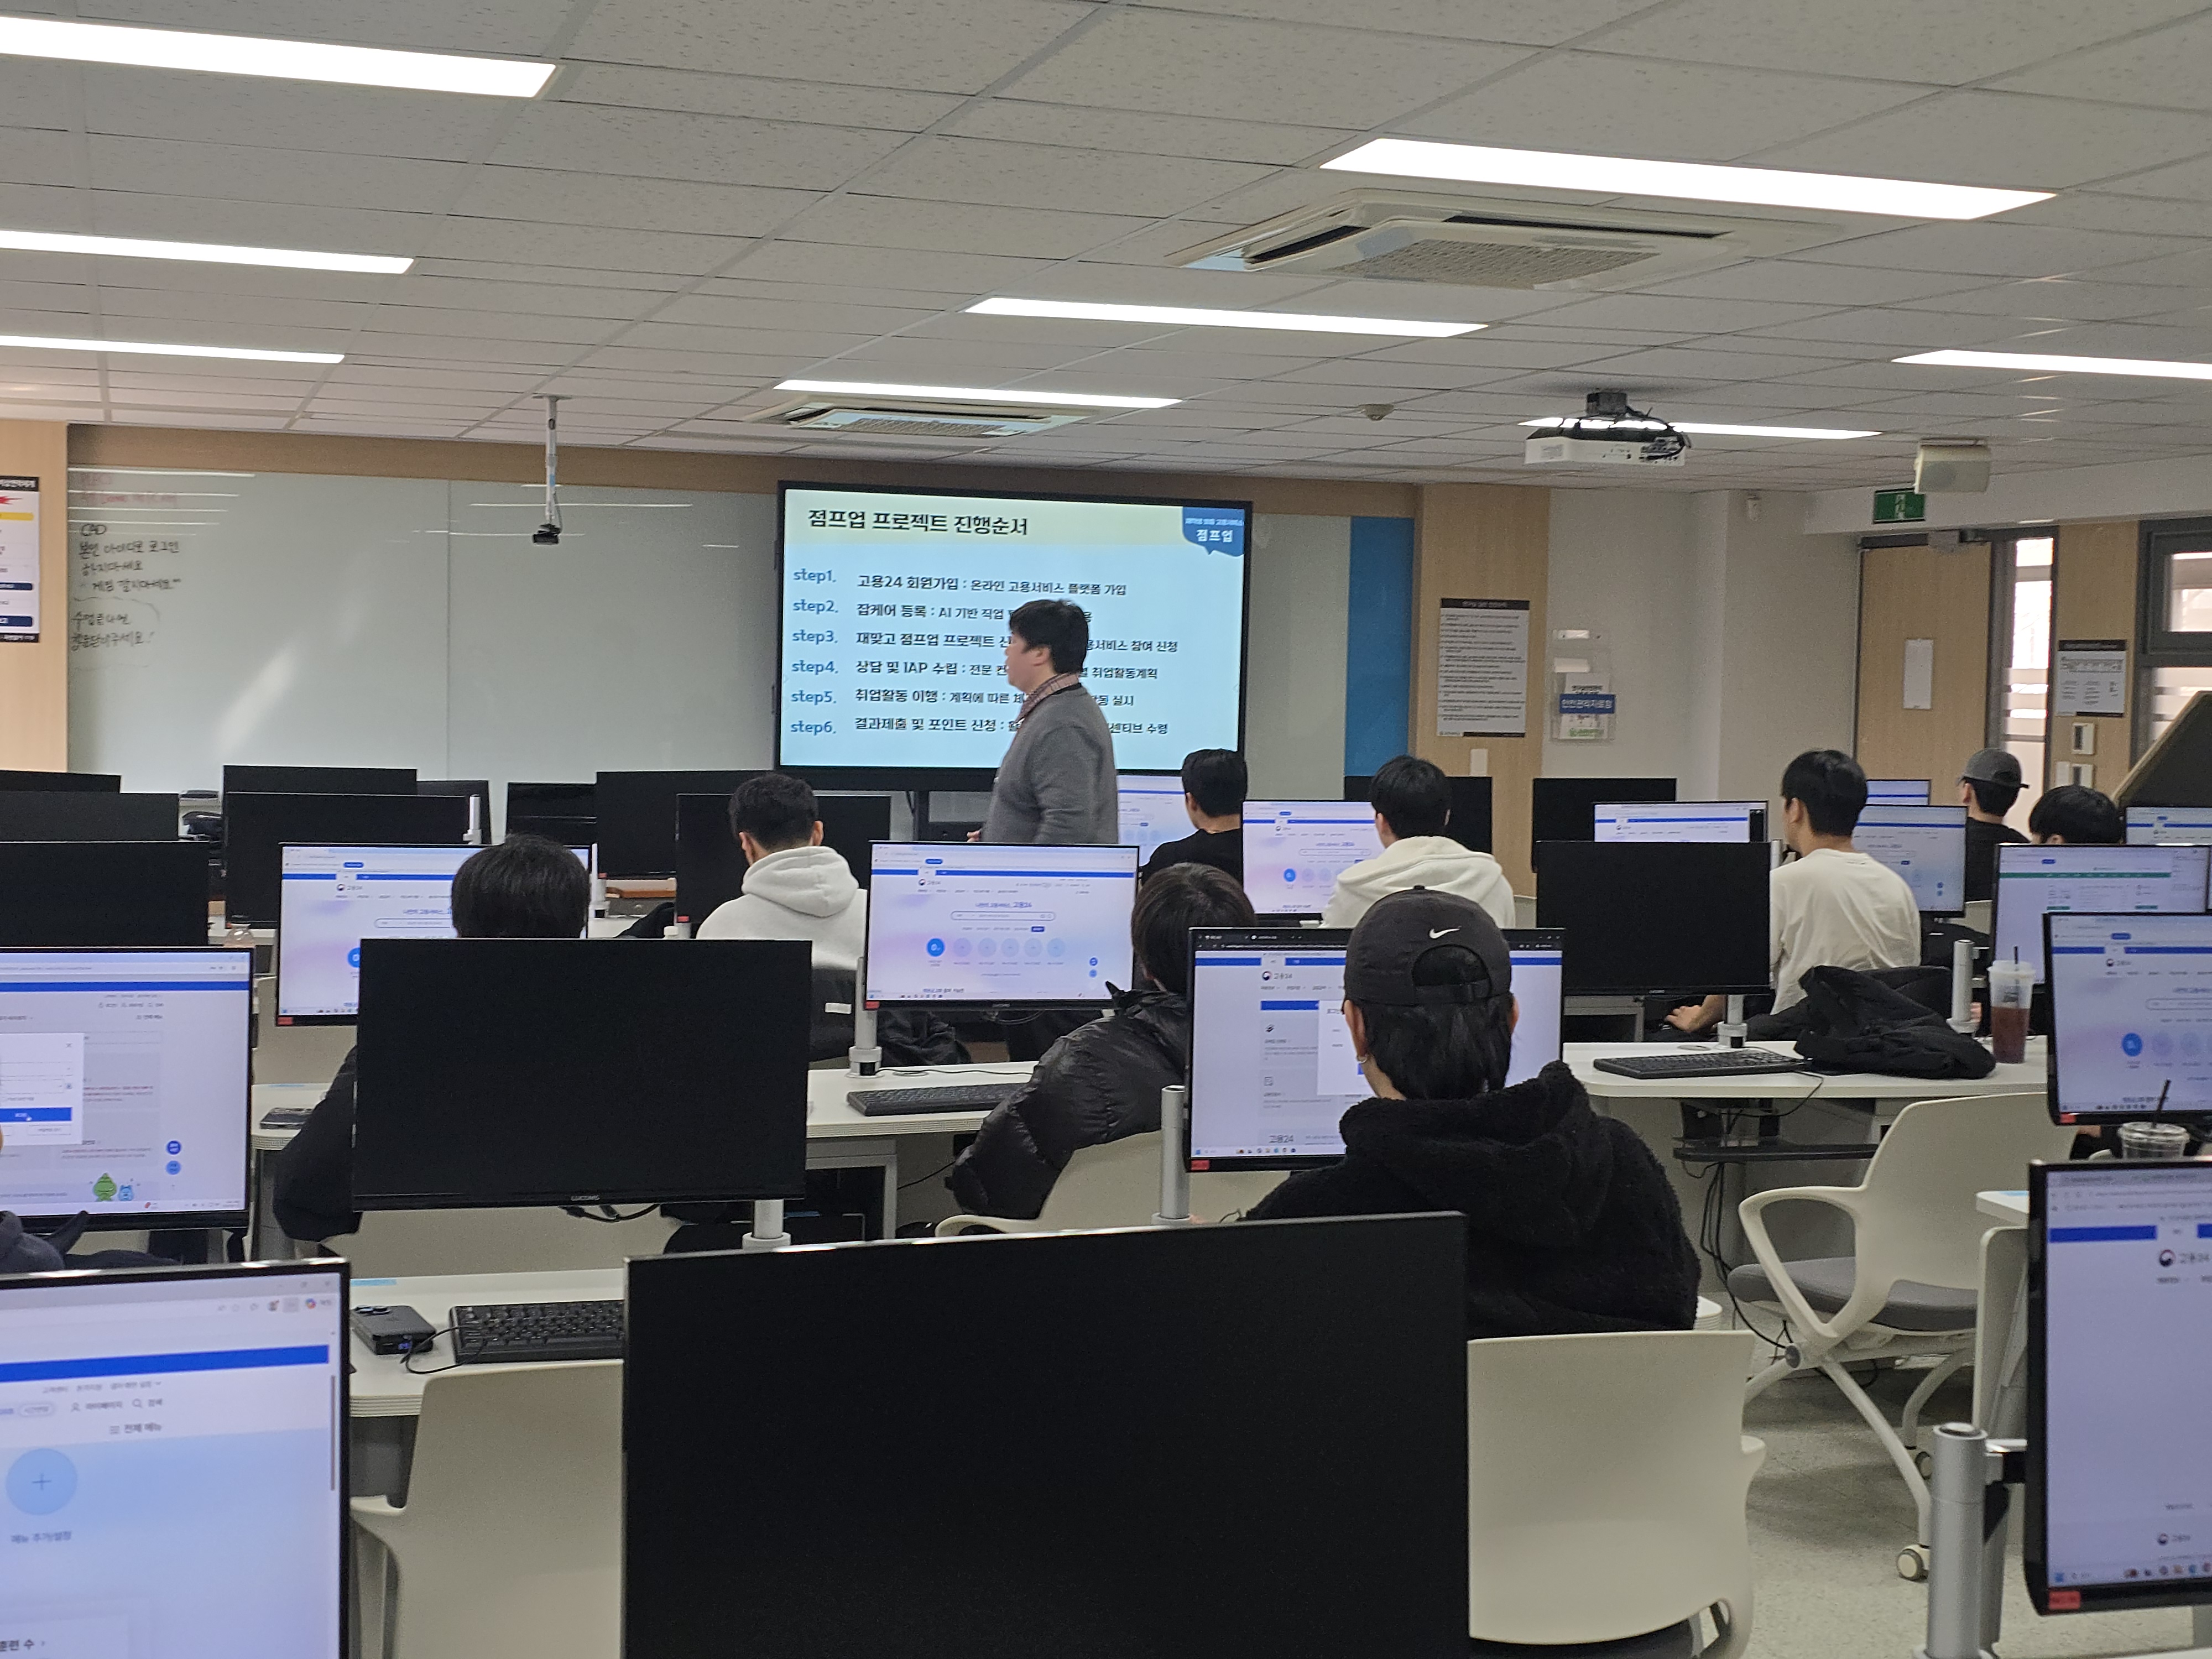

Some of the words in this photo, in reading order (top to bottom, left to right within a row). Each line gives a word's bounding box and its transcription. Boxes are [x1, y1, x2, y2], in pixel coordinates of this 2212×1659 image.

[808, 510, 865, 529] 점프업
[873, 513, 947, 531] 프로젝트
[954, 516, 1027, 535] 진행순서
[1196, 529, 1233, 542] 점프업
[794, 568, 836, 584] step1.
[858, 576, 902, 588] 고용24
[907, 576, 958, 589] 회원가입
[971, 580, 1004, 591] 온라인
[1009, 582, 1064, 593] 고용서비스
[1068, 584, 1100, 594] 플랫폼
[1105, 585, 1126, 595] 가입
[794, 599, 838, 614] step2.
[857, 604, 896, 616] 잡케어
[901, 605, 926, 617] 등록
[938, 608, 951, 617] AI
[956, 608, 978, 619] 기반
[982, 609, 1004, 619] 직업
[793, 629, 837, 645] step3.
[857, 633, 896, 644] 재맞고
[900, 634, 938, 646] 점프업
[943, 635, 994, 647] 프로젝트
[1131, 641, 1152, 651] 참여
[1156, 641, 1177, 652] 신청
[792, 660, 838, 675] step4.
[856, 661, 882, 672] 상담
[887, 661, 899, 673] 및
[904, 662, 927, 673] IAP
[933, 663, 957, 674] 수립
[969, 665, 992, 675] 전문
[1092, 667, 1157, 679] 취업활동계획
[792, 690, 836, 705] step5.
[856, 689, 907, 702] 취업활동
[913, 690, 937, 702] 이행
[950, 692, 983, 703] 계획에
[988, 693, 1009, 703] 따른
[1113, 696, 1133, 706] 실시
[791, 721, 836, 735] step6.
[855, 718, 906, 730] 결과제출
[912, 719, 924, 730] 및
[928, 719, 967, 731] 포인트
[972, 720, 995, 732] 신청
[1147, 724, 1167, 734] 수령
